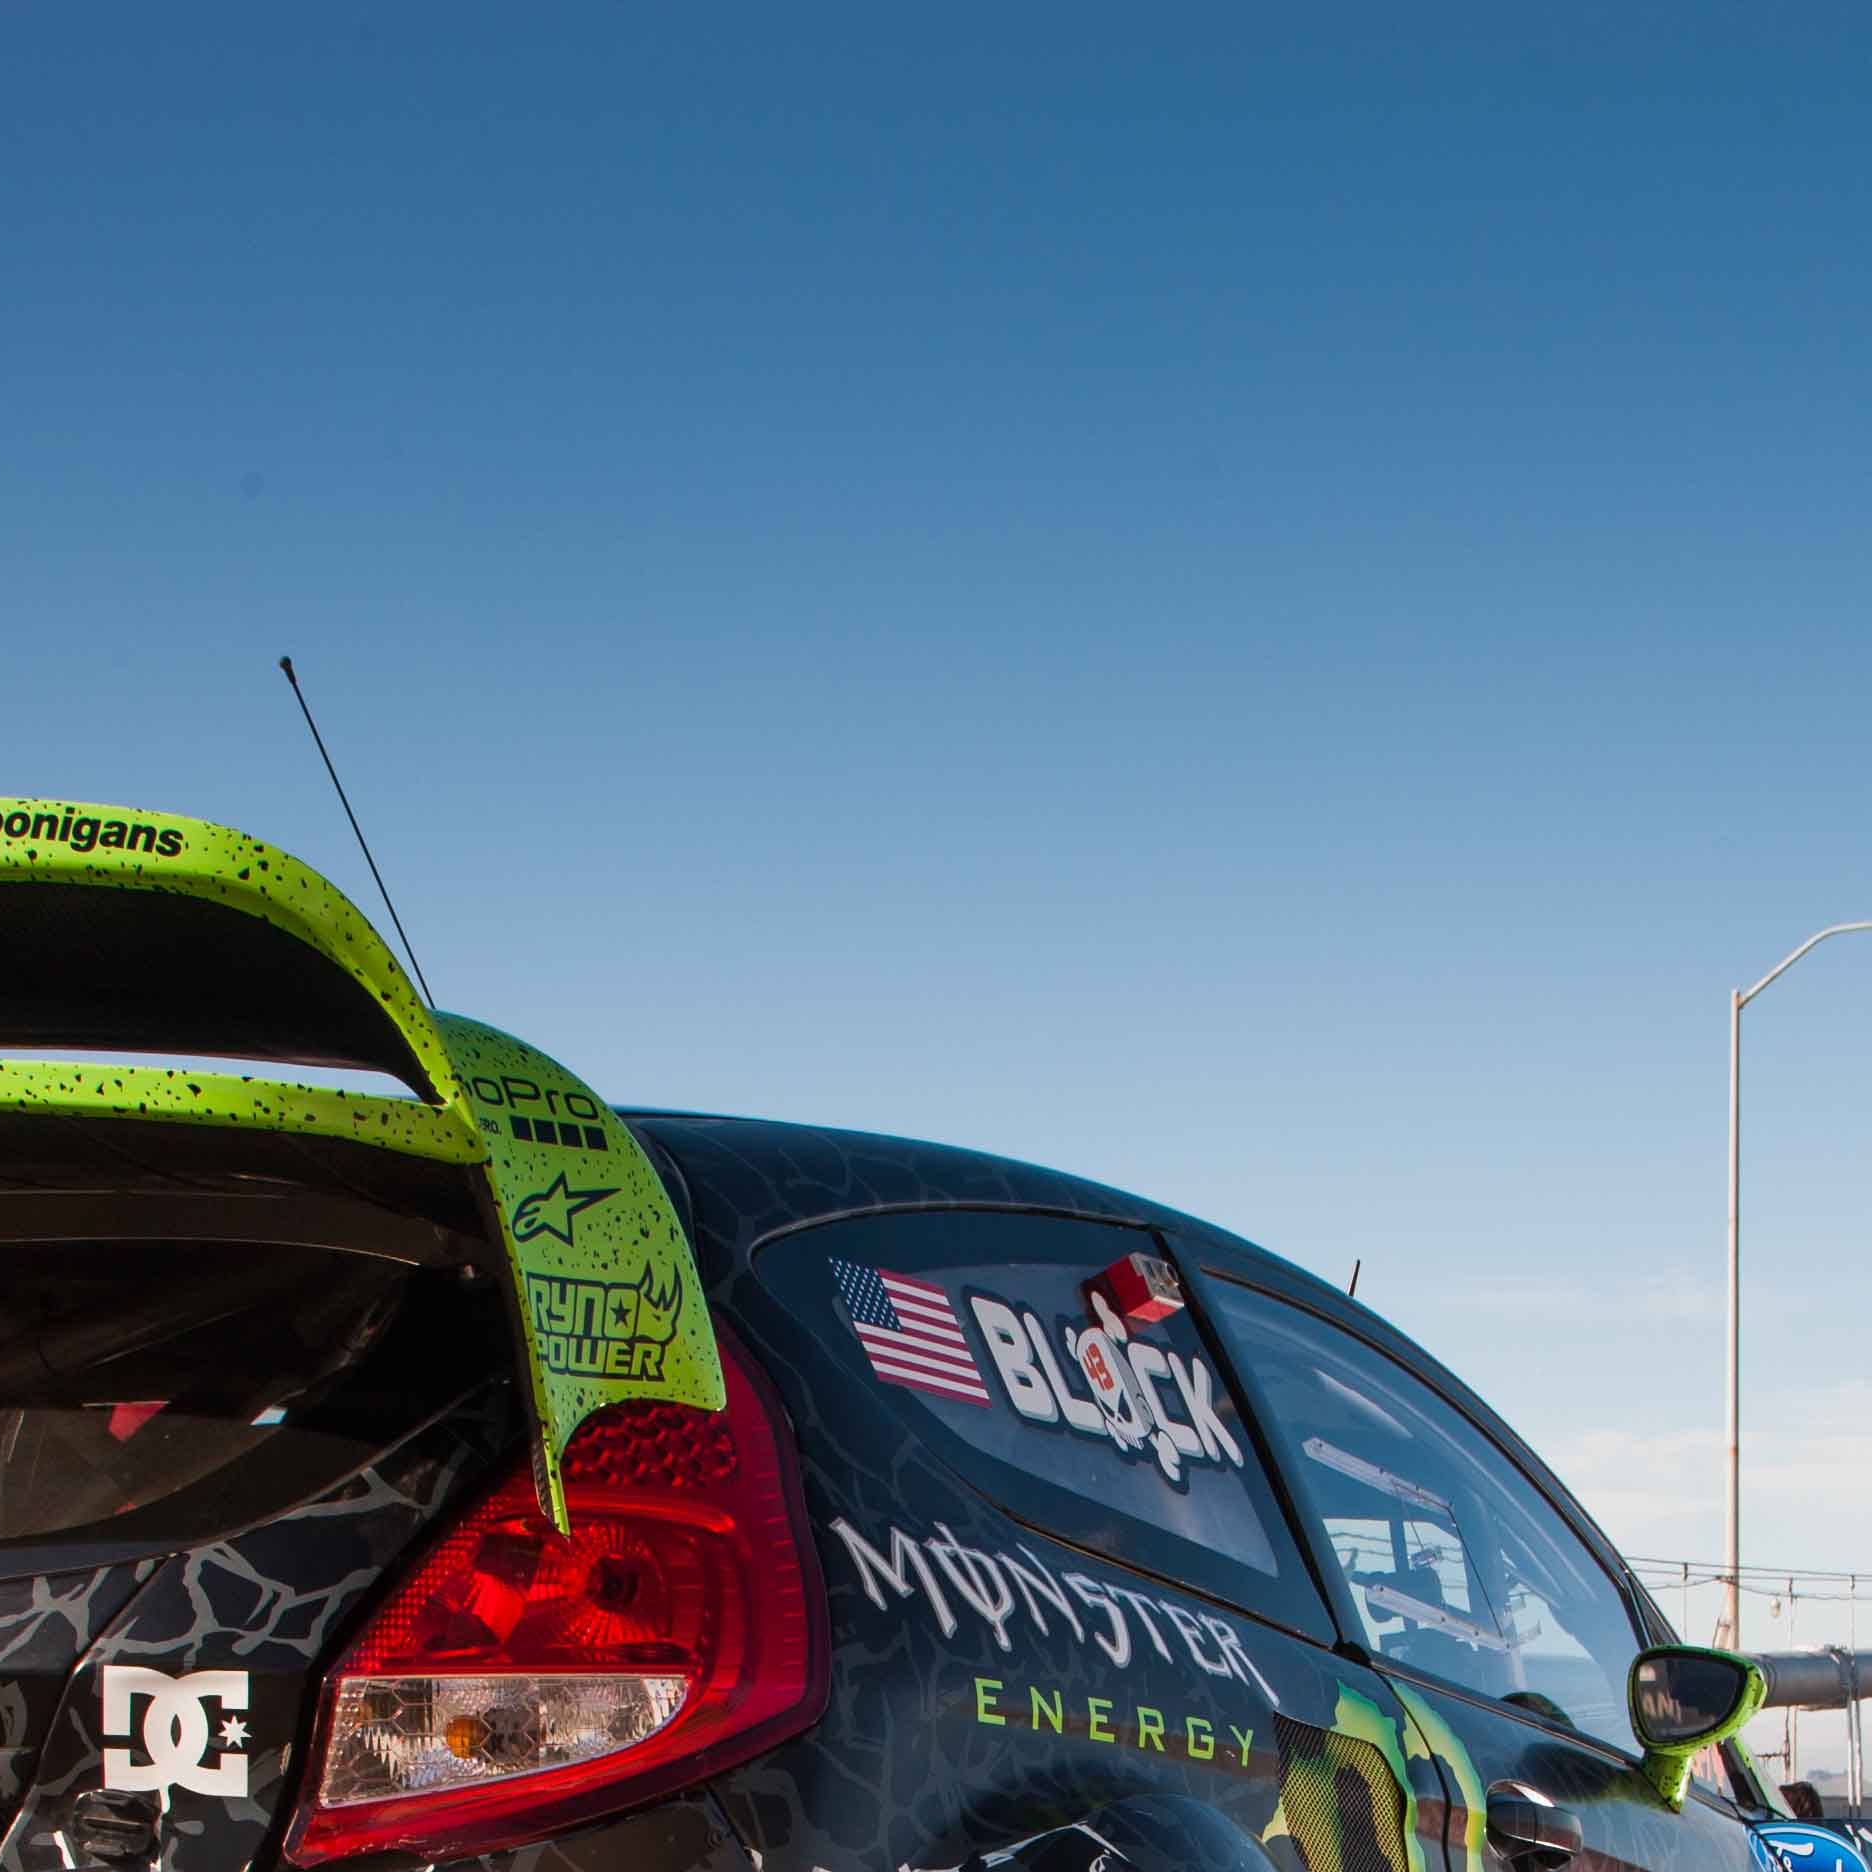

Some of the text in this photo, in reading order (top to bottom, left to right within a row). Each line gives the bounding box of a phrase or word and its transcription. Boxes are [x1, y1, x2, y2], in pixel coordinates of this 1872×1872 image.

[462, 1074, 599, 1121] oPro
[536, 1338, 665, 1383] POWER
[829, 1516, 1281, 1708] MONSTER
[974, 1676, 1255, 1768] ENERGY
